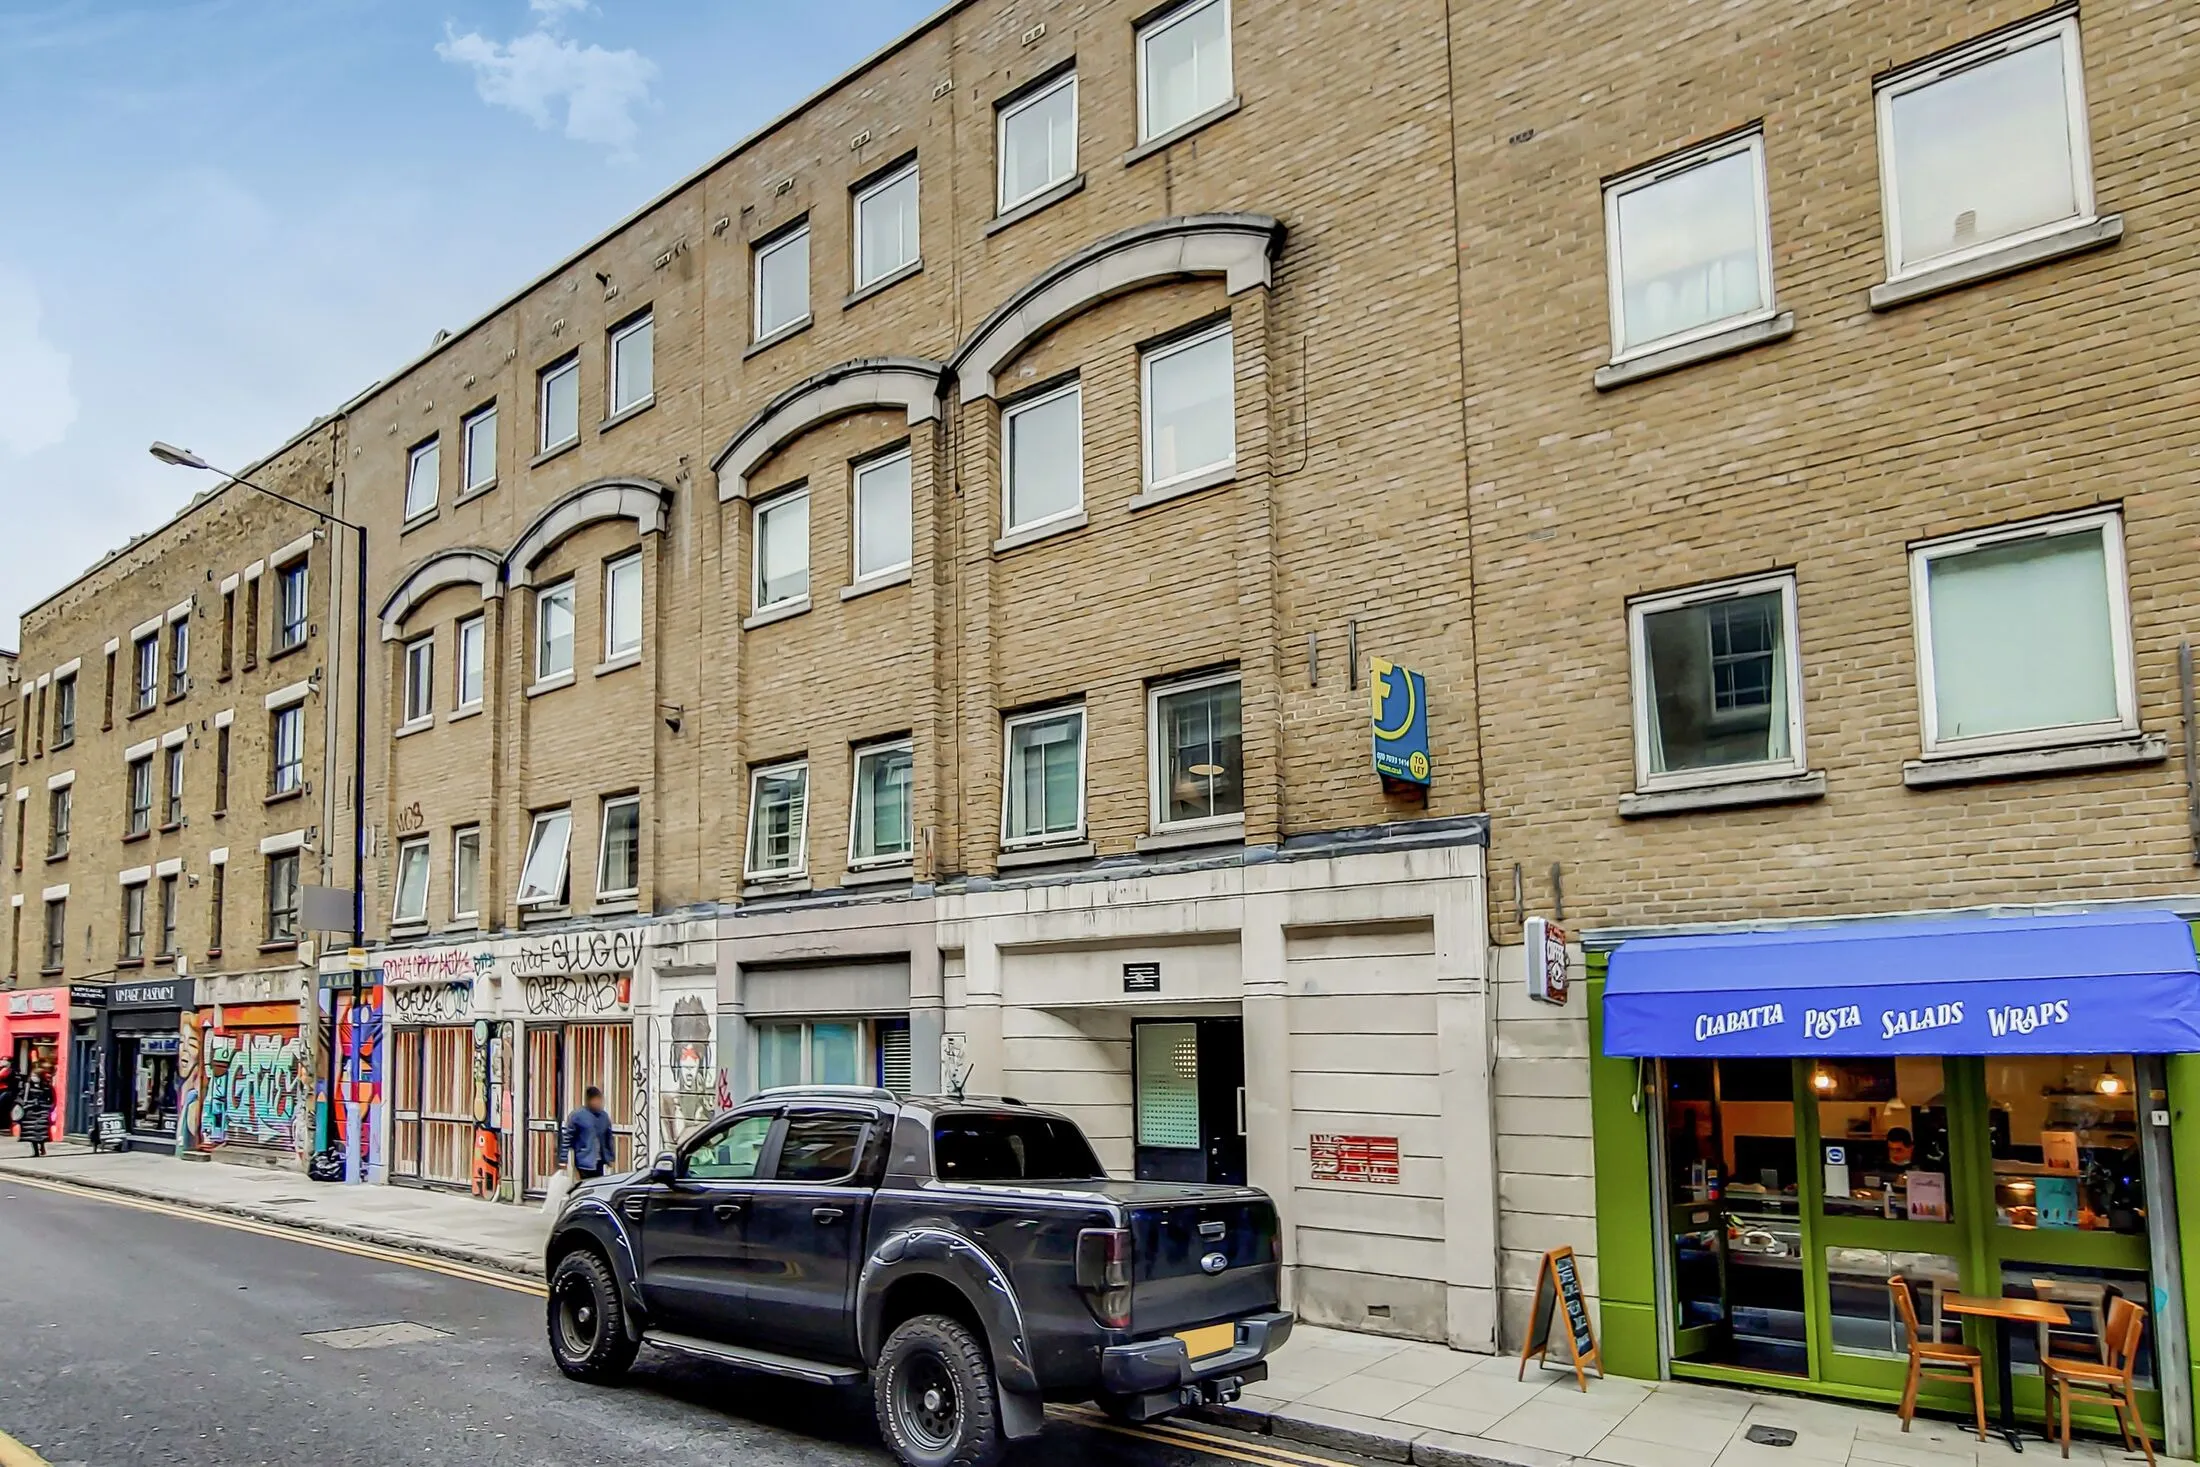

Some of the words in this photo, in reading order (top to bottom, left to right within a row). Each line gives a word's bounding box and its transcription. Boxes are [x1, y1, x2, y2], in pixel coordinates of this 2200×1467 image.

[1413, 765, 1425, 776] LET
[1414, 755, 1424, 765] TO
[552, 931, 611, 972] SLUG
[1695, 1003, 1785, 1041] CIABATTA
[1803, 1005, 1863, 1040] PASTA
[1881, 1001, 1965, 1040] SALADS
[1987, 999, 2070, 1038] WRAPS
